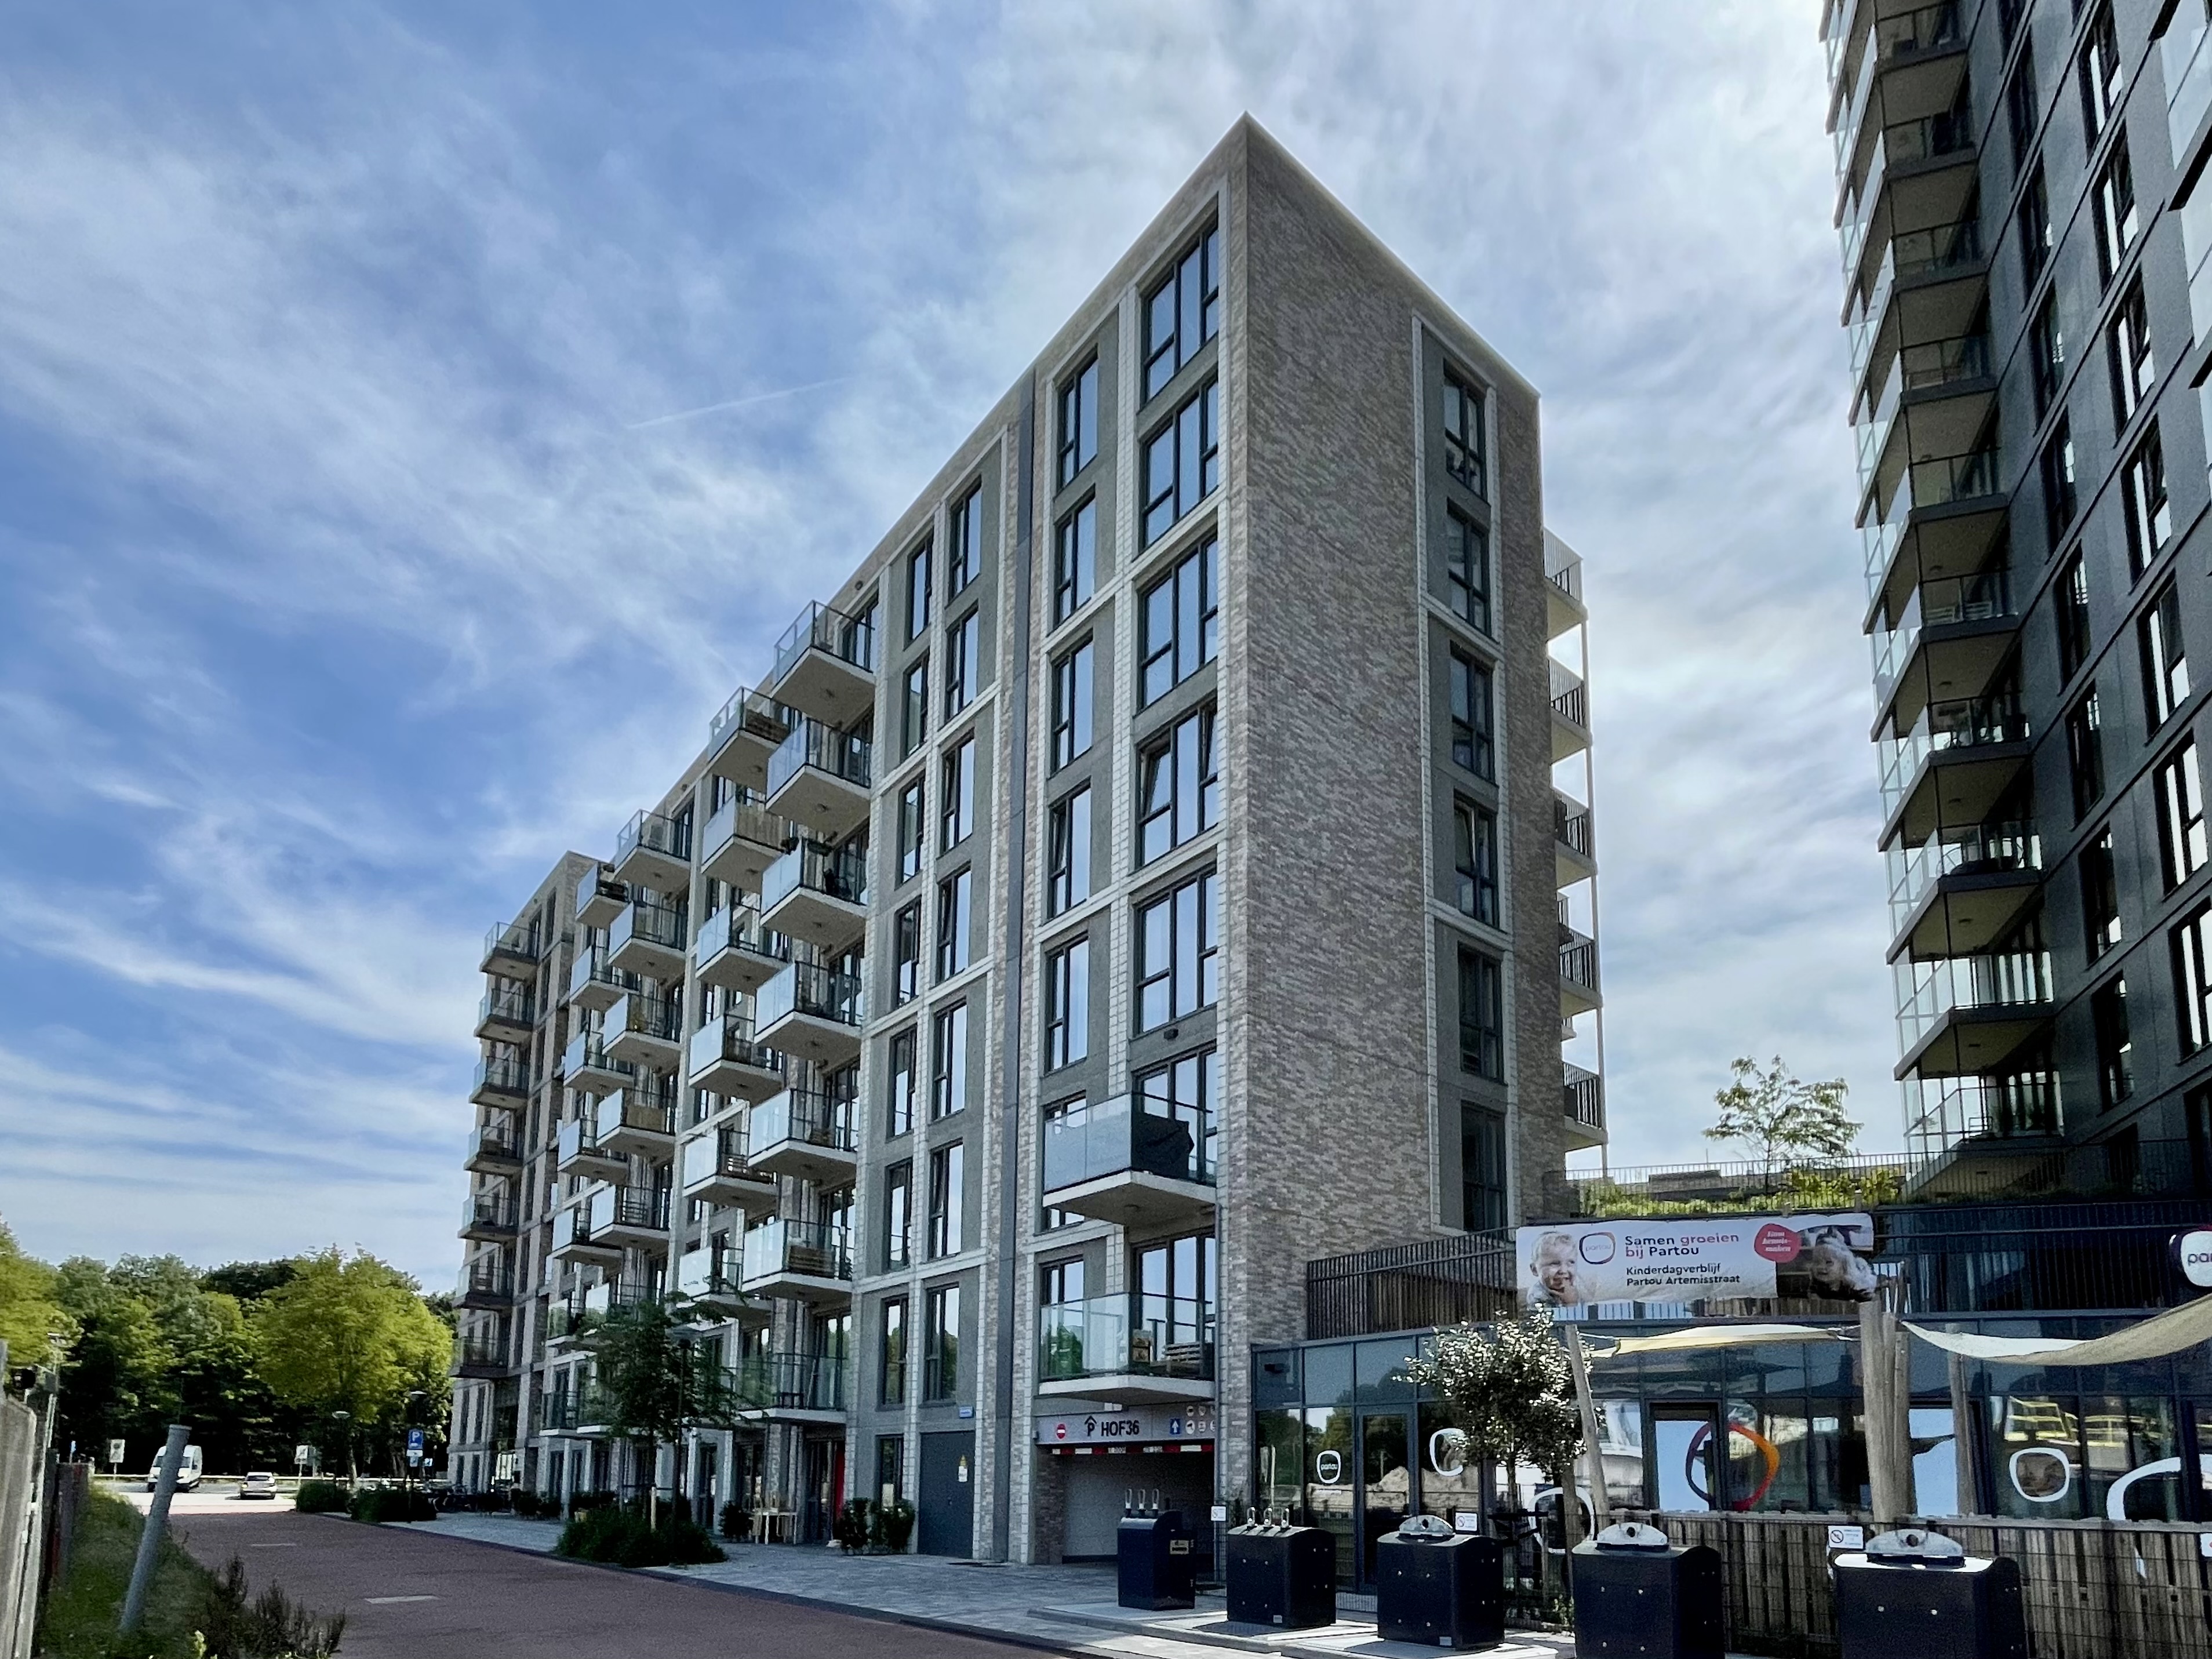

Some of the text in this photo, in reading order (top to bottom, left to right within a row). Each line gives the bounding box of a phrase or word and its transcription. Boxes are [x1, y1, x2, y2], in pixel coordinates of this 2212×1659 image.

[1625, 1232, 1740, 1246] Samen groeien
[1625, 1245, 1700, 1259] bij Partou
[2187, 1253, 2212, 1267] pa
[1626, 1262, 1722, 1276] Kinderdagverblijf
[1627, 1274, 1741, 1286] Partou Artemisstraat
[1101, 1420, 1140, 1437] HOF36
